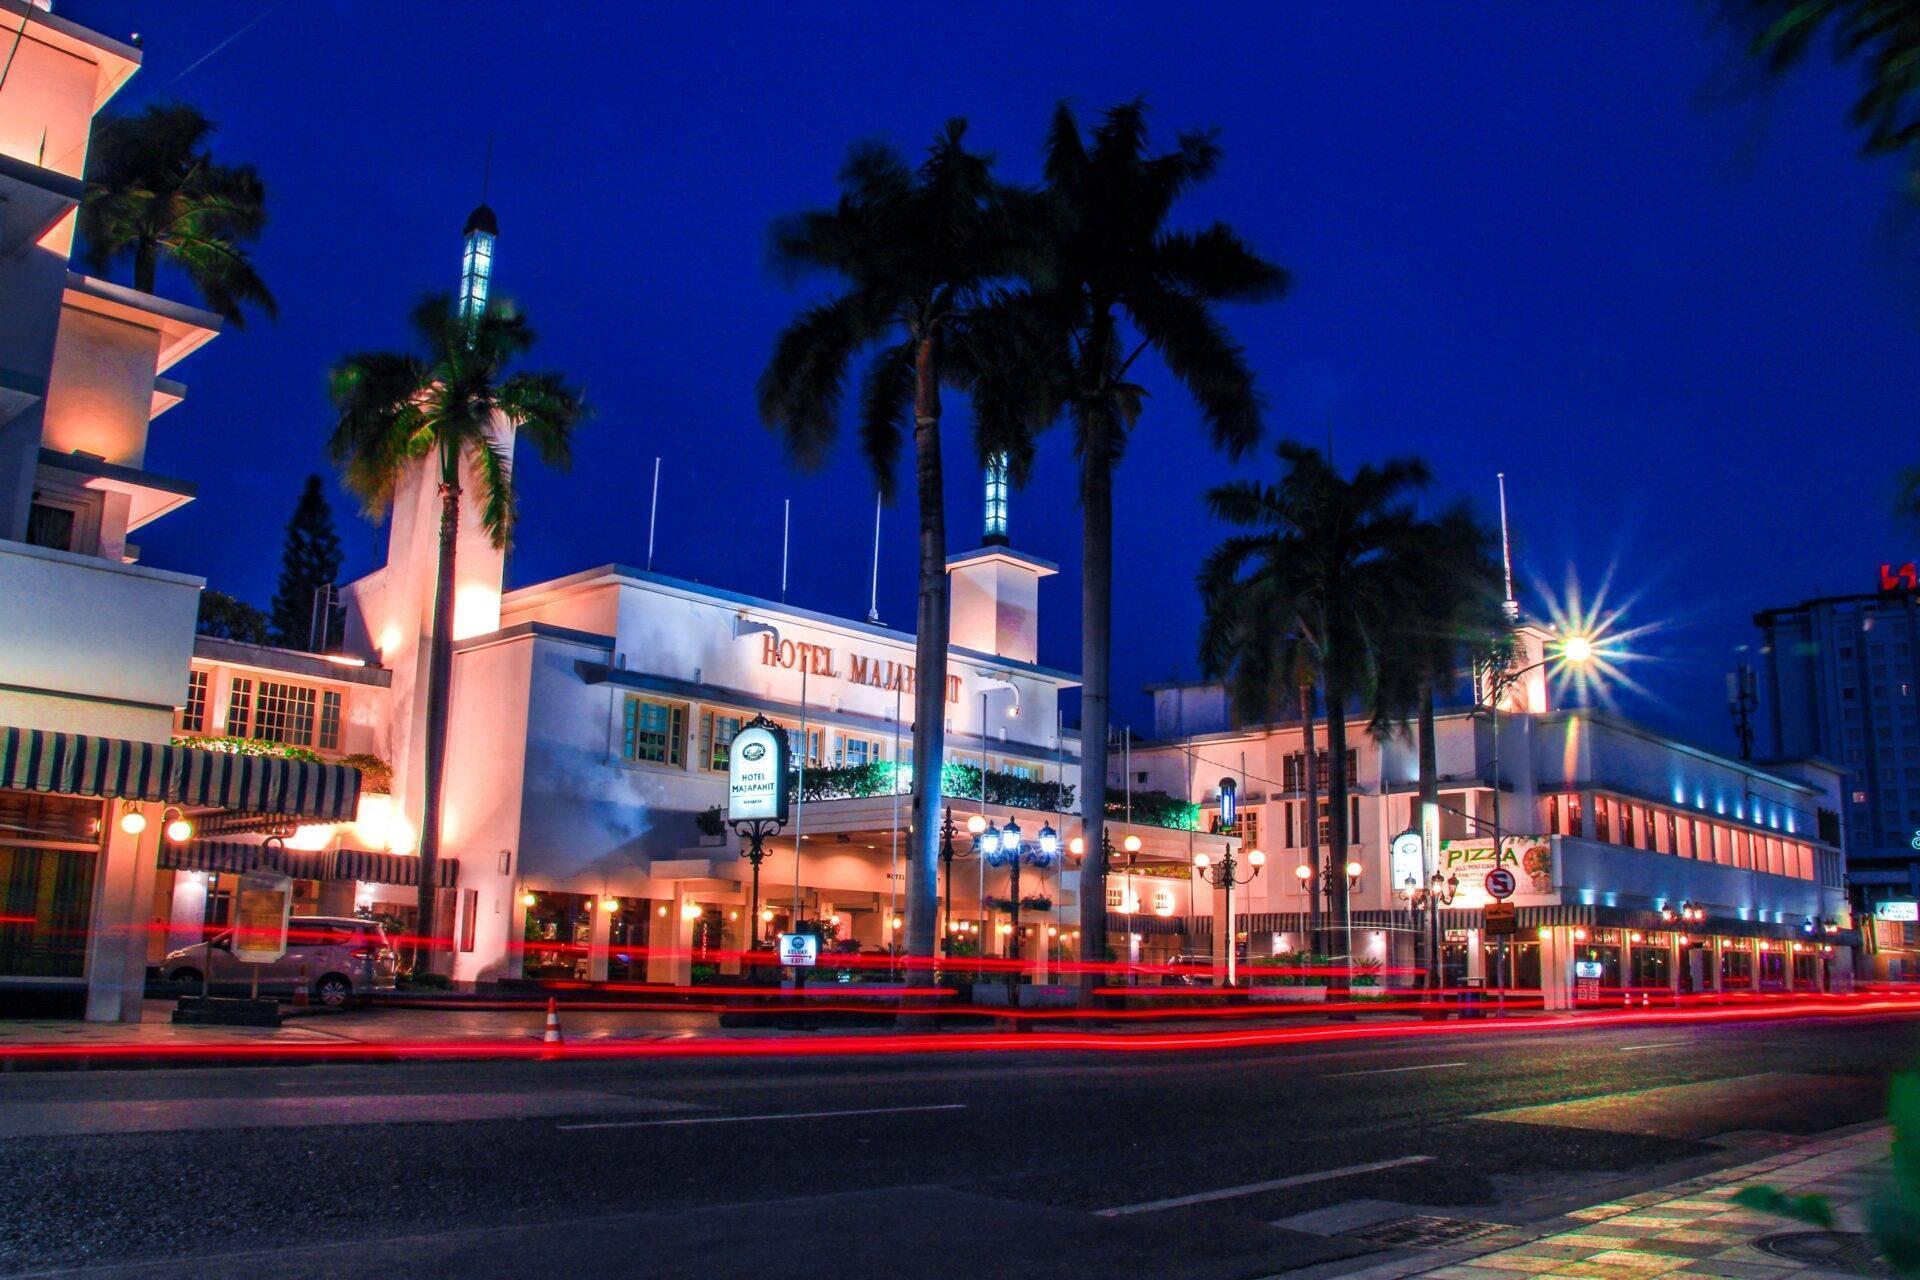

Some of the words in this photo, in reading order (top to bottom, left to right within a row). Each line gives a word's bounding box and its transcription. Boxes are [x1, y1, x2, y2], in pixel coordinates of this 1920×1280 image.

[762, 633, 836, 678] HOTEL
[849, 653, 962, 703] MAJAPIT
[742, 772, 765, 782] HOTEL
[732, 782, 775, 793] MAJAPAHIT
[1447, 848, 1518, 868] PIZZA
